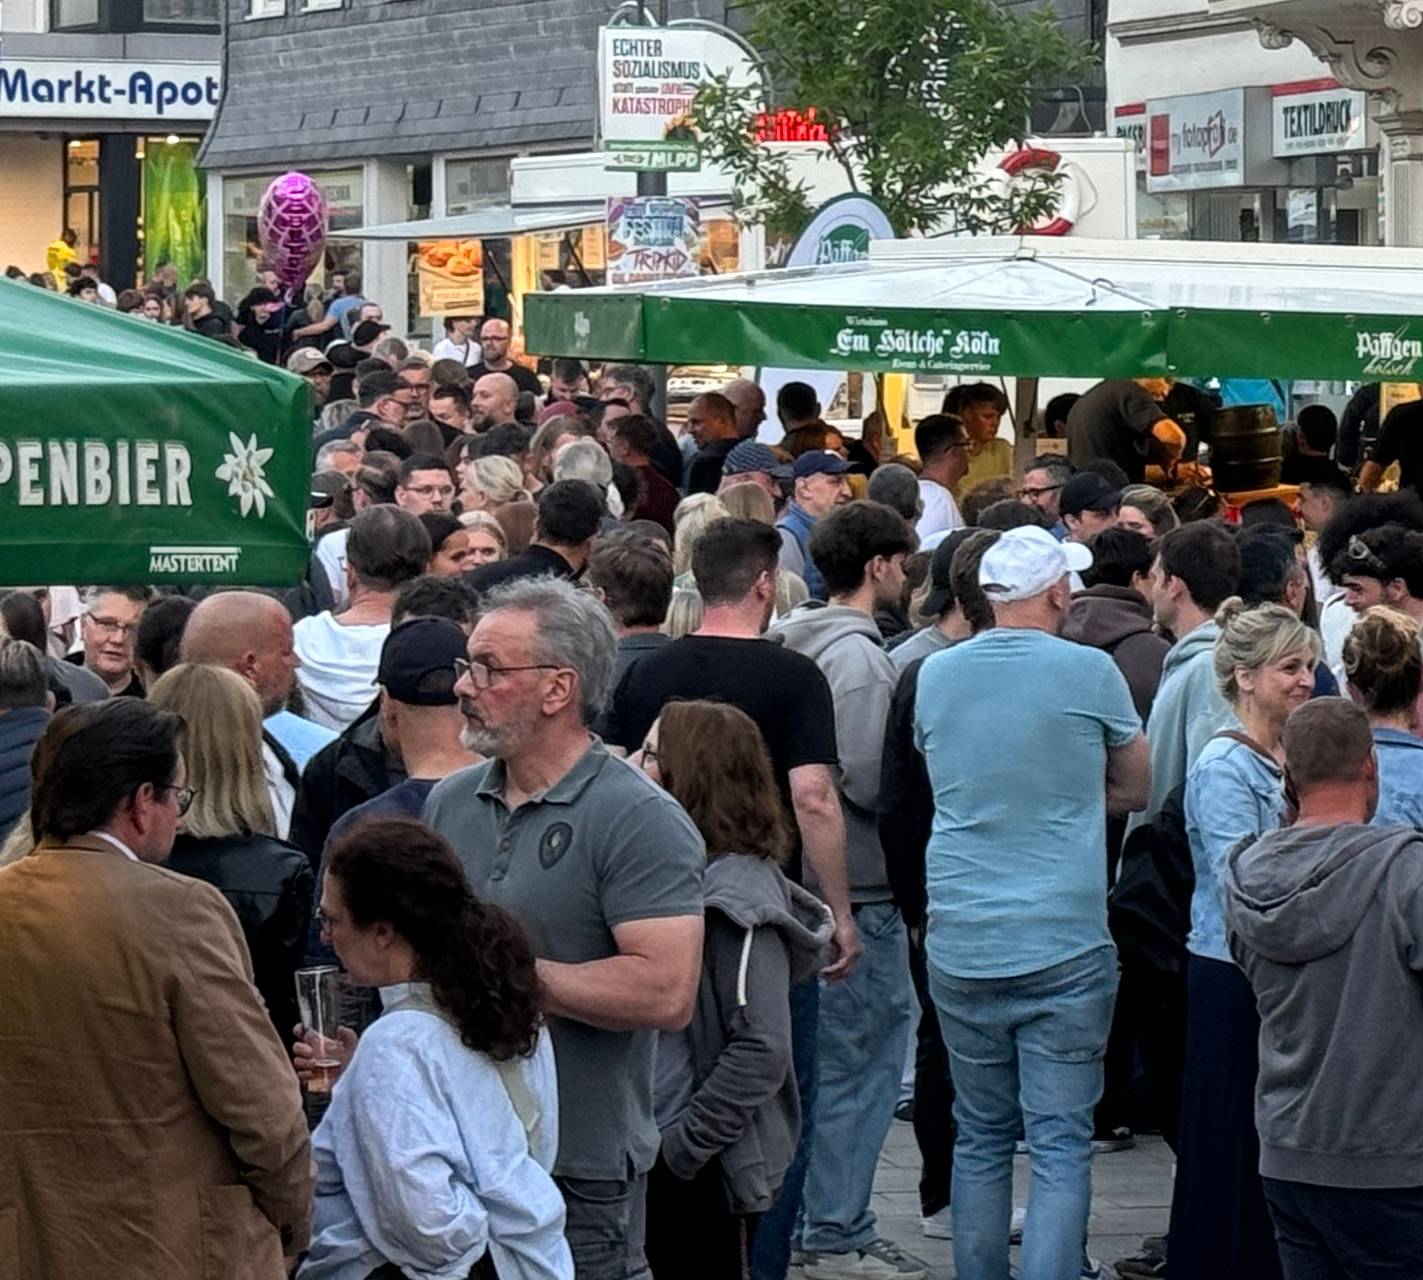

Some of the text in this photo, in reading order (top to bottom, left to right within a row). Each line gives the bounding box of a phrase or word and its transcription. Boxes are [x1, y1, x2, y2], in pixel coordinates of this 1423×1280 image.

[612, 39, 662, 57] ECHTER
[612, 60, 701, 79] SOZIALISMUS
[0, 68, 219, 115] Markt-Apot
[1283, 99, 1353, 139] TEXTILDRUCK
[651, 151, 699, 169] MLPD
[949, 329, 1001, 359] Köln
[1355, 331, 1423, 361] Päffgen
[149, 553, 240, 573] MASTERTENT
